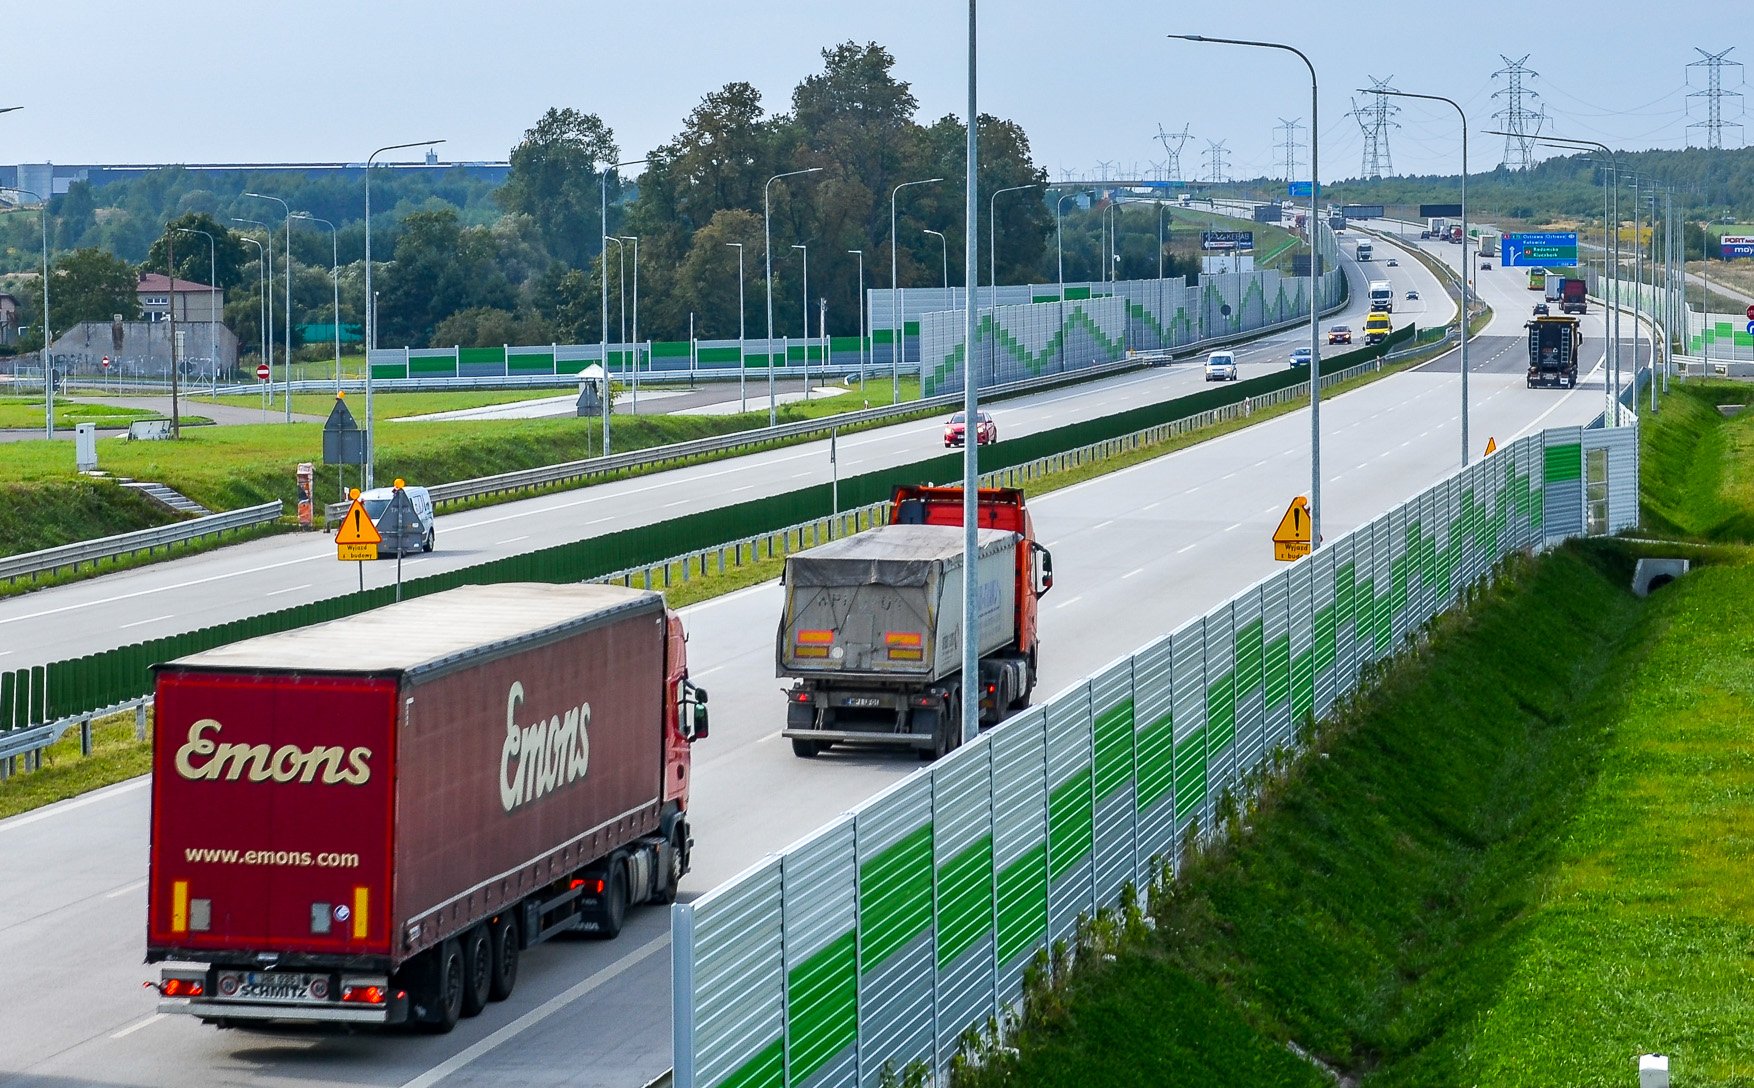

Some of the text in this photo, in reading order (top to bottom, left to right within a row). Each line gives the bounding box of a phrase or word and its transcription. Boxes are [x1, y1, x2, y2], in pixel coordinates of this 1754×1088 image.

[175, 718, 372, 785] Emons
[500, 680, 591, 812] Emons
[185, 848, 359, 867] www.emons.com
[240, 985, 308, 998] SCHMITZ
